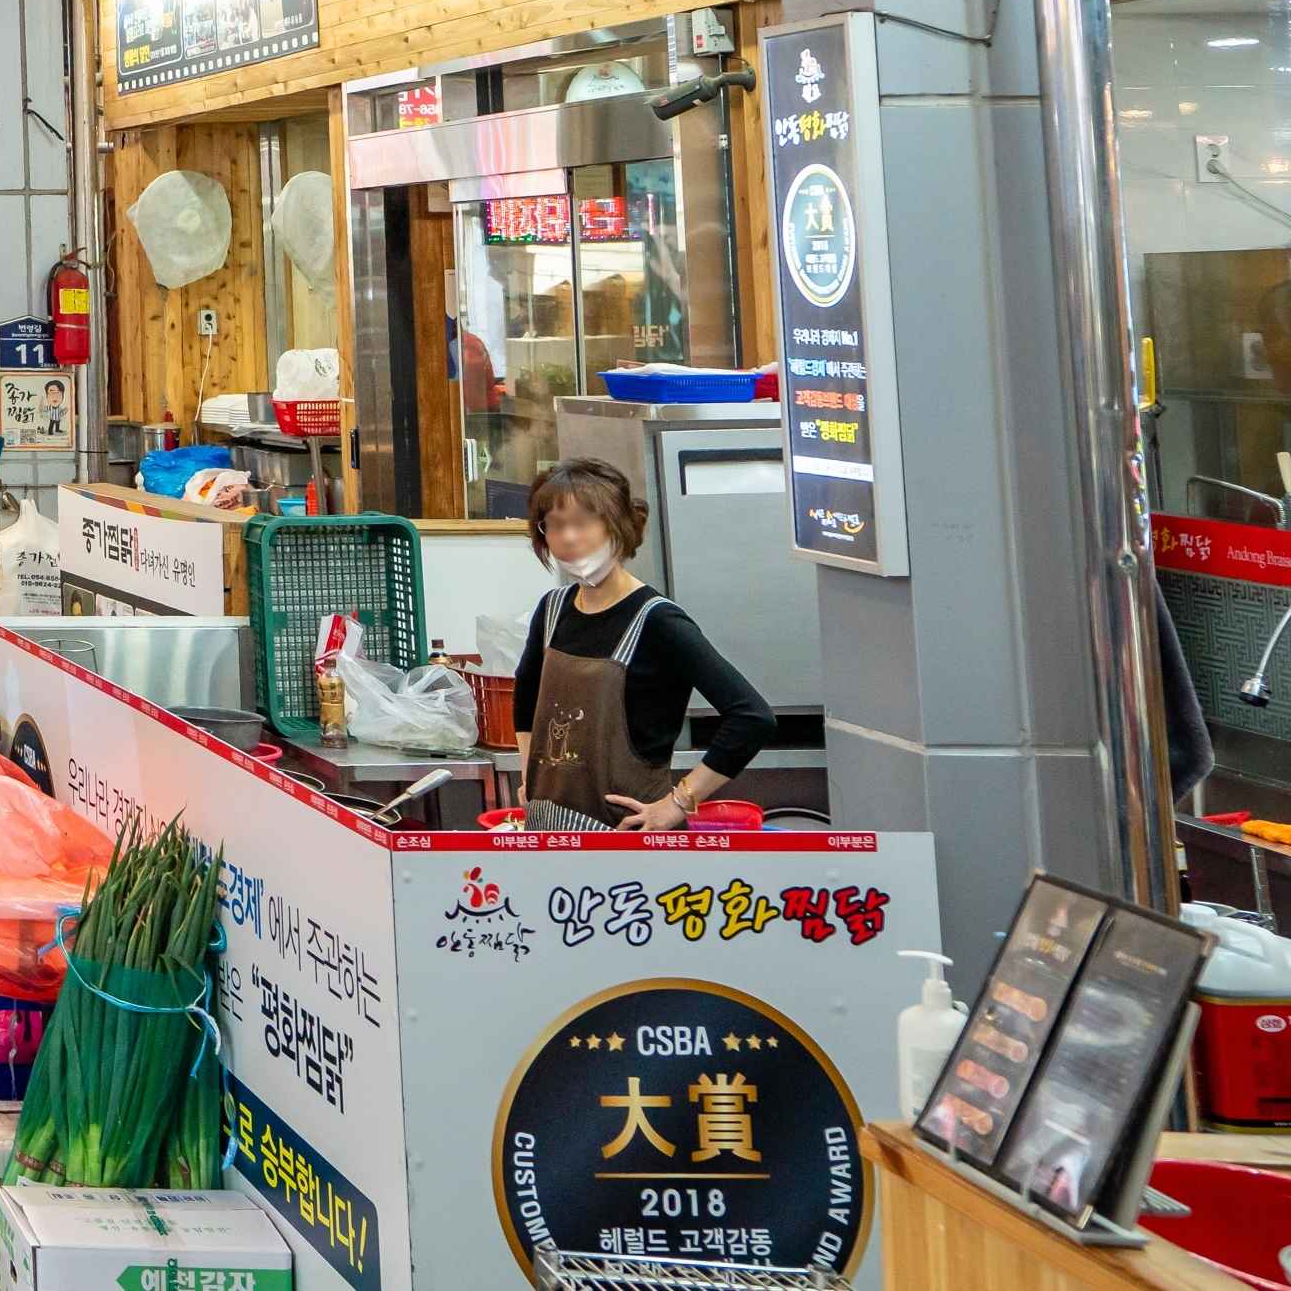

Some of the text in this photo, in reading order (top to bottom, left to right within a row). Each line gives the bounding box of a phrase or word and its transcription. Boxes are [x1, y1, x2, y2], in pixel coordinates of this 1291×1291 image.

[15, 343, 45, 365] 11
[17, 547, 60, 568] 종가찜
[82, 517, 197, 588] 종가찜닭 다녀가신 유명인
[1227, 545, 1267, 569] Andong
[68, 756, 111, 830] 우리나라
[397, 835, 431, 848] 손조심
[493, 835, 581, 848] 이부분은 손조심
[643, 834, 730, 848] 이부분은 손조심
[828, 834, 875, 848] 이부분은
[548, 879, 890, 948] 안동평화찜닭
[436, 921, 536, 963] 안동찜닭
[269, 895, 381, 1029] 에서 주관하는
[636, 1024, 713, 1057] CSBA
[597, 1072, 763, 1163] 大賞
[826, 1125, 854, 1225] AWARD
[260, 1123, 367, 1274] 승부합니다!
[640, 1188, 727, 1218] 2018
[598, 1227, 773, 1257] 헤럴드 고객감동
